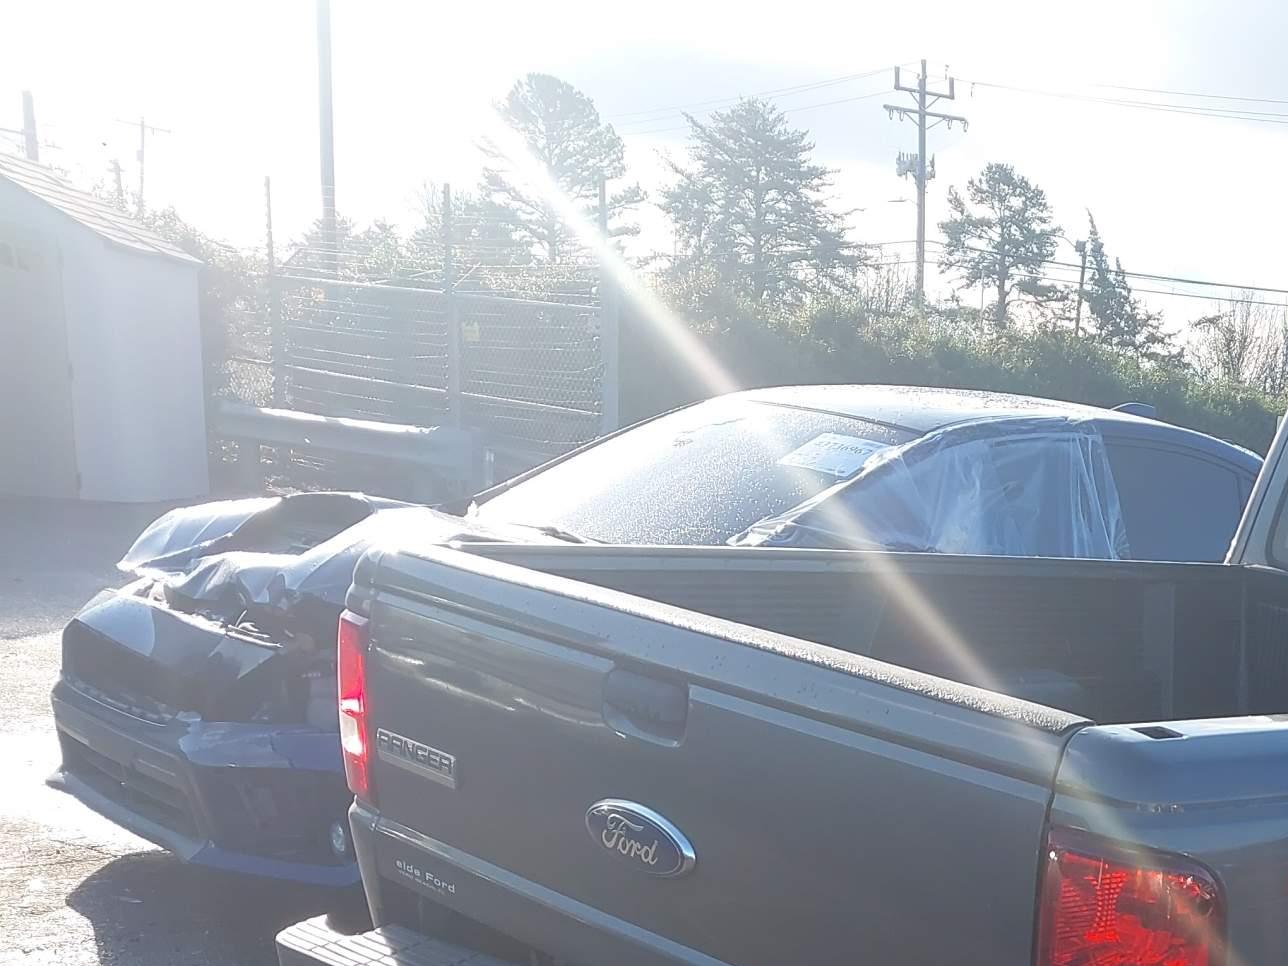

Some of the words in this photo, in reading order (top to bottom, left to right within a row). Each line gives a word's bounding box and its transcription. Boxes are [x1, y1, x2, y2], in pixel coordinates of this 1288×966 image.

[378, 729, 453, 776] RANGER
[602, 813, 658, 865] Ford
[425, 872, 456, 894] Ford
